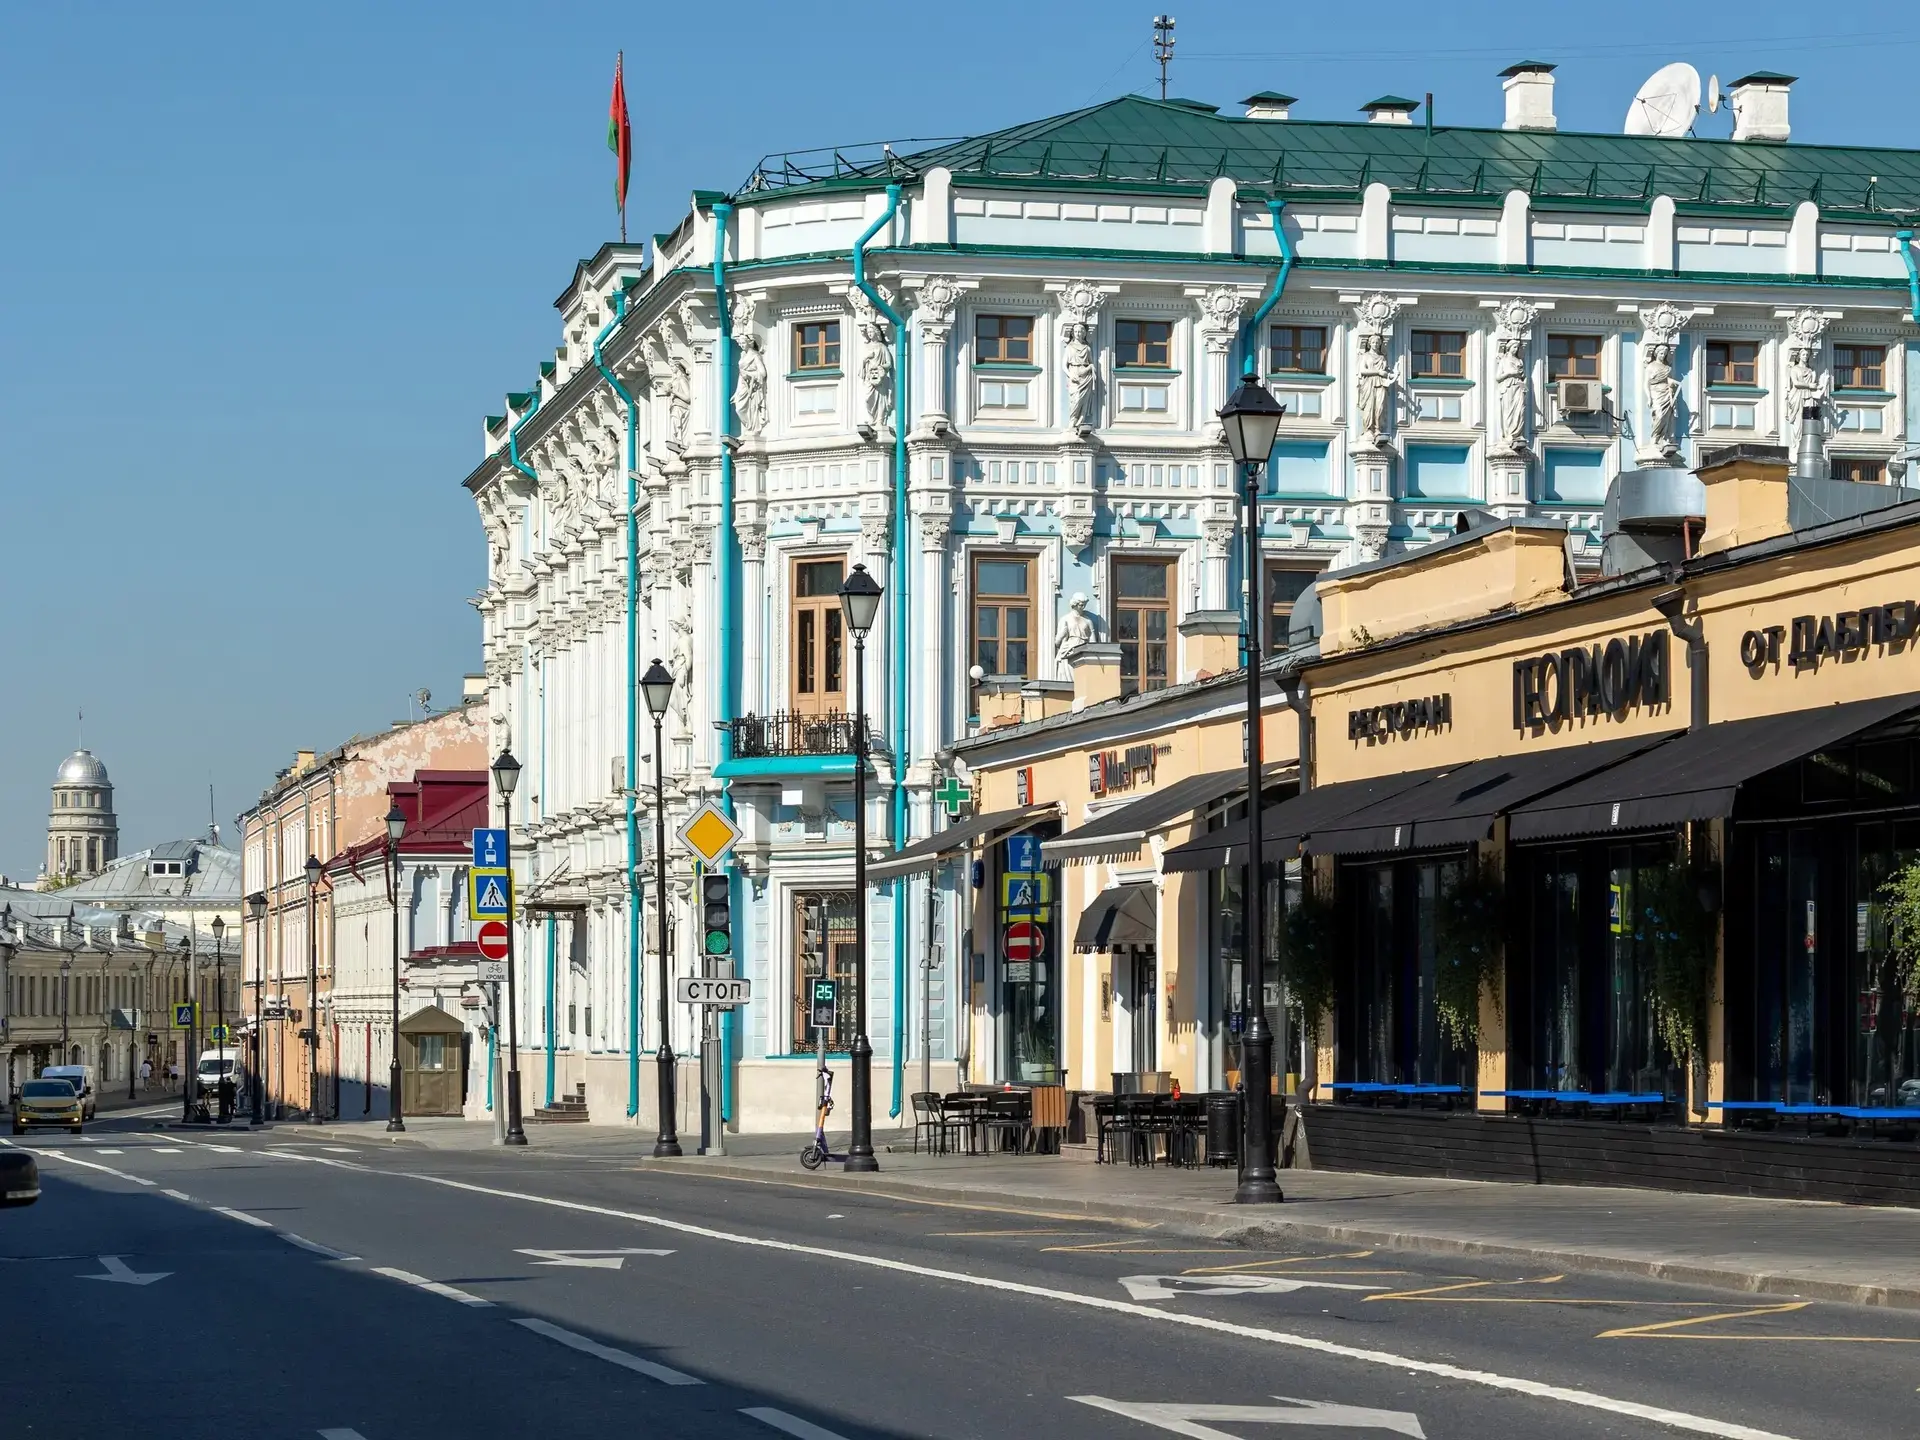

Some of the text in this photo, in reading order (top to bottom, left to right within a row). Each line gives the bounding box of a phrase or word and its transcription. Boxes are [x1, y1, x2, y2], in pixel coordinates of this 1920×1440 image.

[1741, 625, 1785, 668] ОТ
[1513, 629, 1668, 730] ГЕОГРАФИЯ
[1348, 693, 1451, 740] РЕСТОРАН
[688, 982, 741, 1000] СТОП
[816, 984, 833, 999] 25
